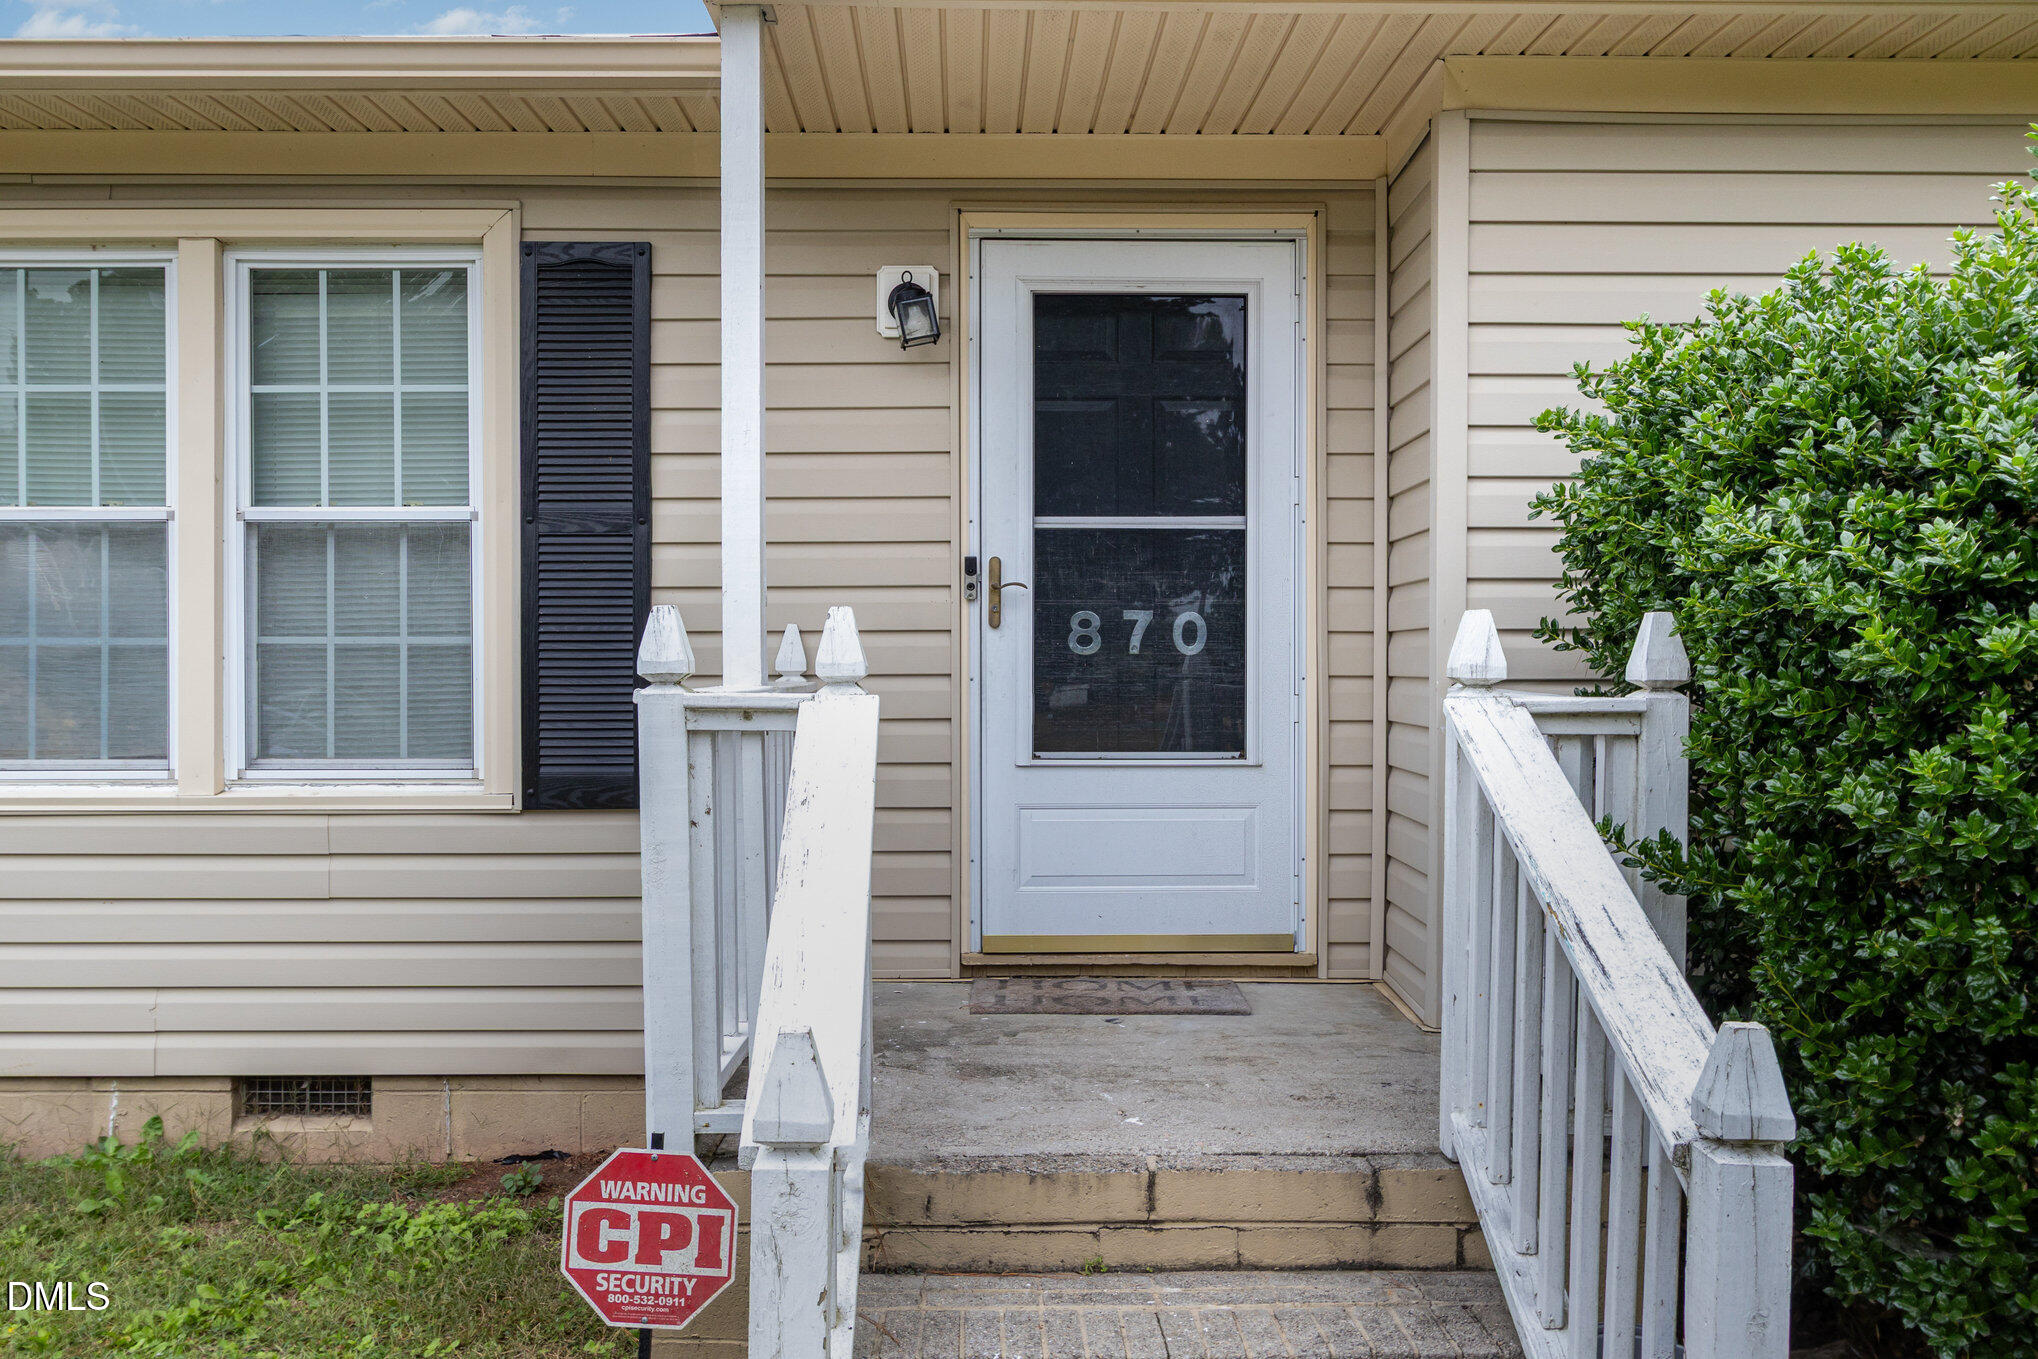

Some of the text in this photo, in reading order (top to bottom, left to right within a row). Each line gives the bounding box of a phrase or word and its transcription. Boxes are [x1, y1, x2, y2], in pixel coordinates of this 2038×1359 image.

[1068, 610, 1207, 656] 870
[600, 1180, 706, 1204] WARNING
[577, 1207, 725, 1270] CPI
[596, 1273, 698, 1296] SECURITY
[607, 1293, 685, 1307] 800-532-0911
[621, 1305, 669, 1313] cpisecurity.com
